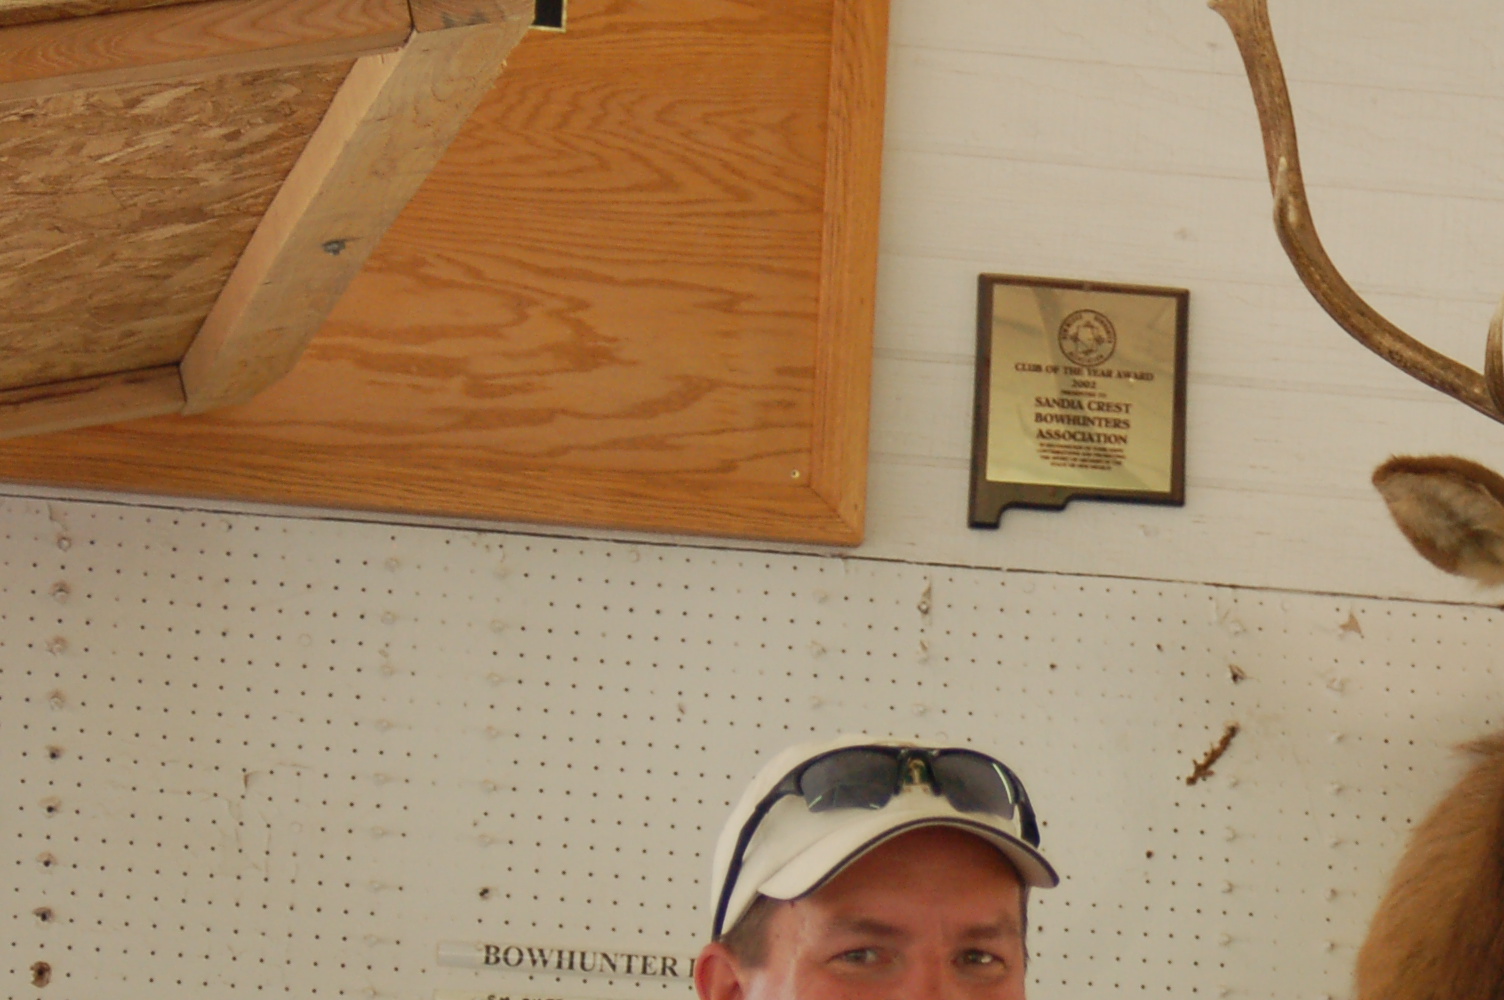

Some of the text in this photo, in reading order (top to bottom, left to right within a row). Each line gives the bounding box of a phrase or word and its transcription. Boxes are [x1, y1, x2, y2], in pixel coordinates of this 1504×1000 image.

[1014, 362, 1154, 381] CLUB OF THE YEAR AWARD
[1034, 396, 1133, 414] SANDIA CREST
[1034, 412, 1131, 430] BOWHUNTERS
[1036, 428, 1129, 445] ASSOCIATION
[483, 943, 679, 978] BOWHUNTER
